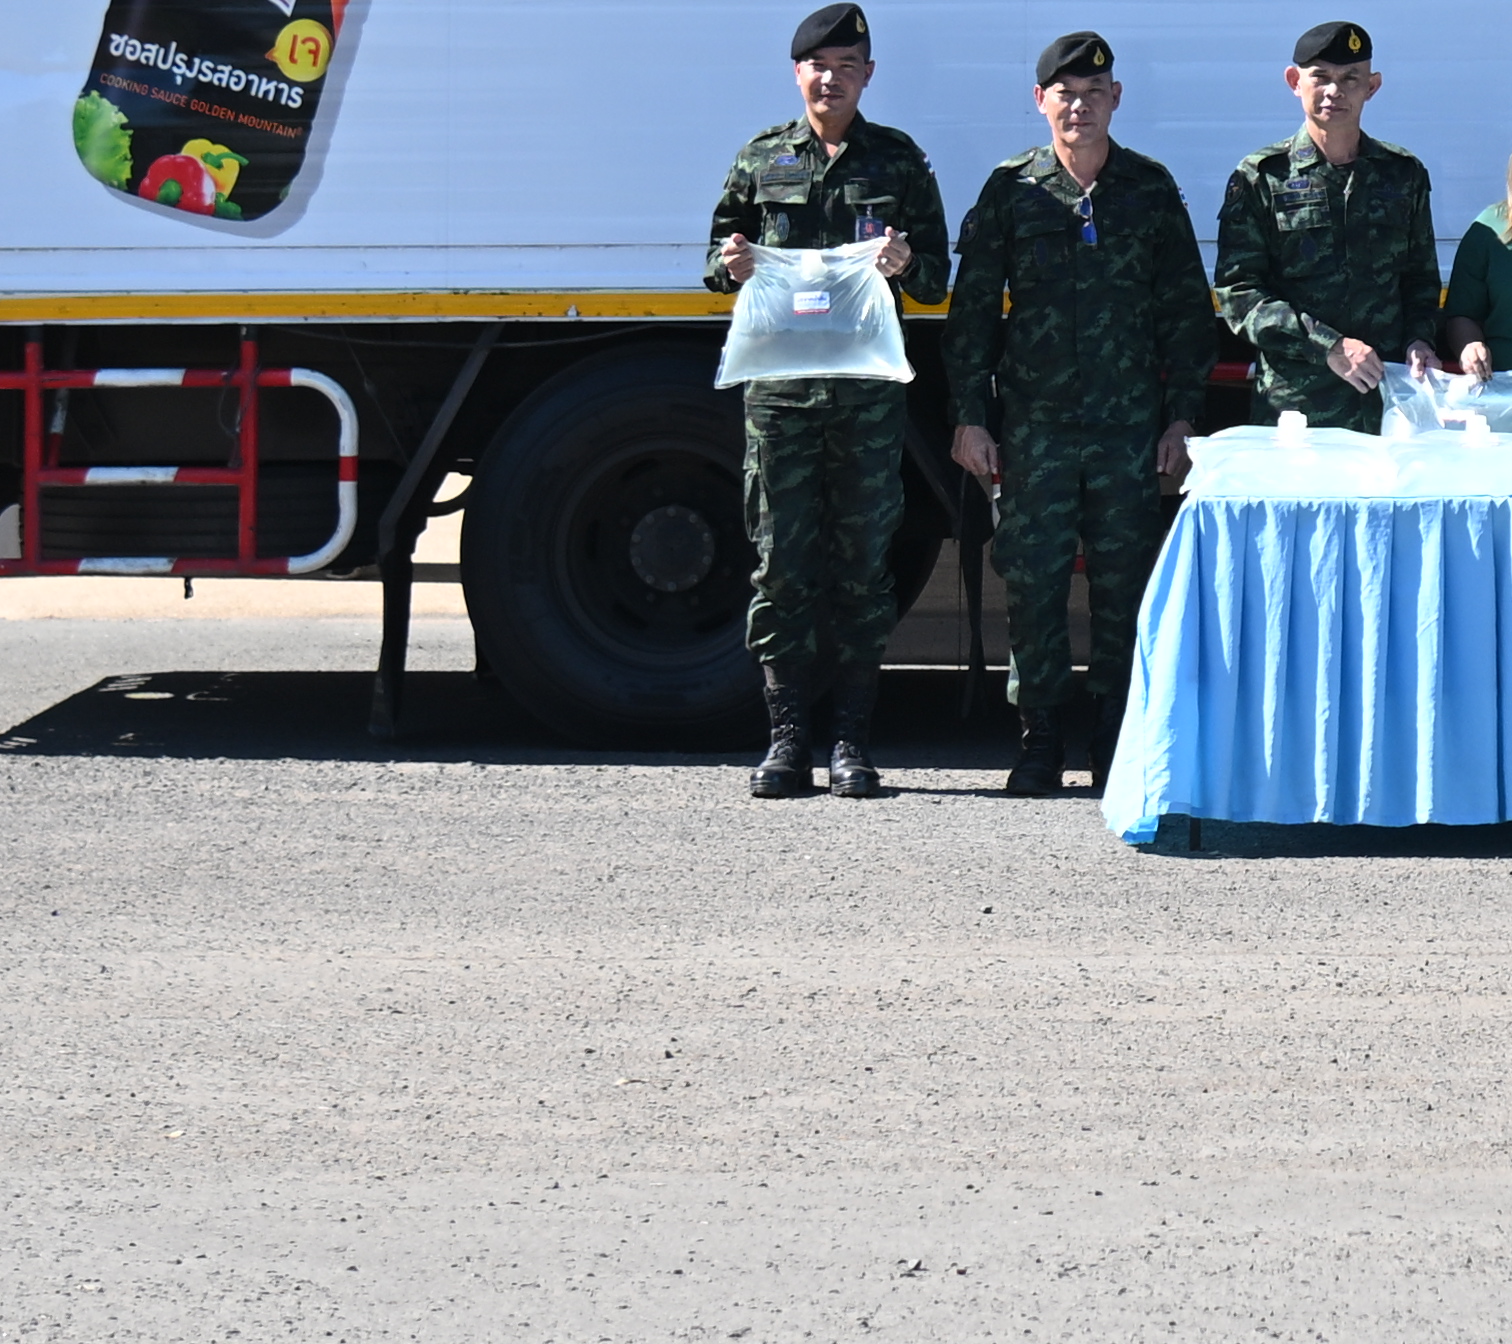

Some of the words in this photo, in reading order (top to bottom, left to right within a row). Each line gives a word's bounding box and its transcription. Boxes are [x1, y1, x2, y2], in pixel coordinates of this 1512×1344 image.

[109, 33, 304, 109] ซอสปรุงรสอาหาร
[288, 33, 322, 68] เจ
[99, 72, 149, 96] COOKING
[150, 87, 188, 108] SAUCE
[190, 98, 236, 122] GOLDEN
[238, 112, 298, 139] MOUNTAIN
